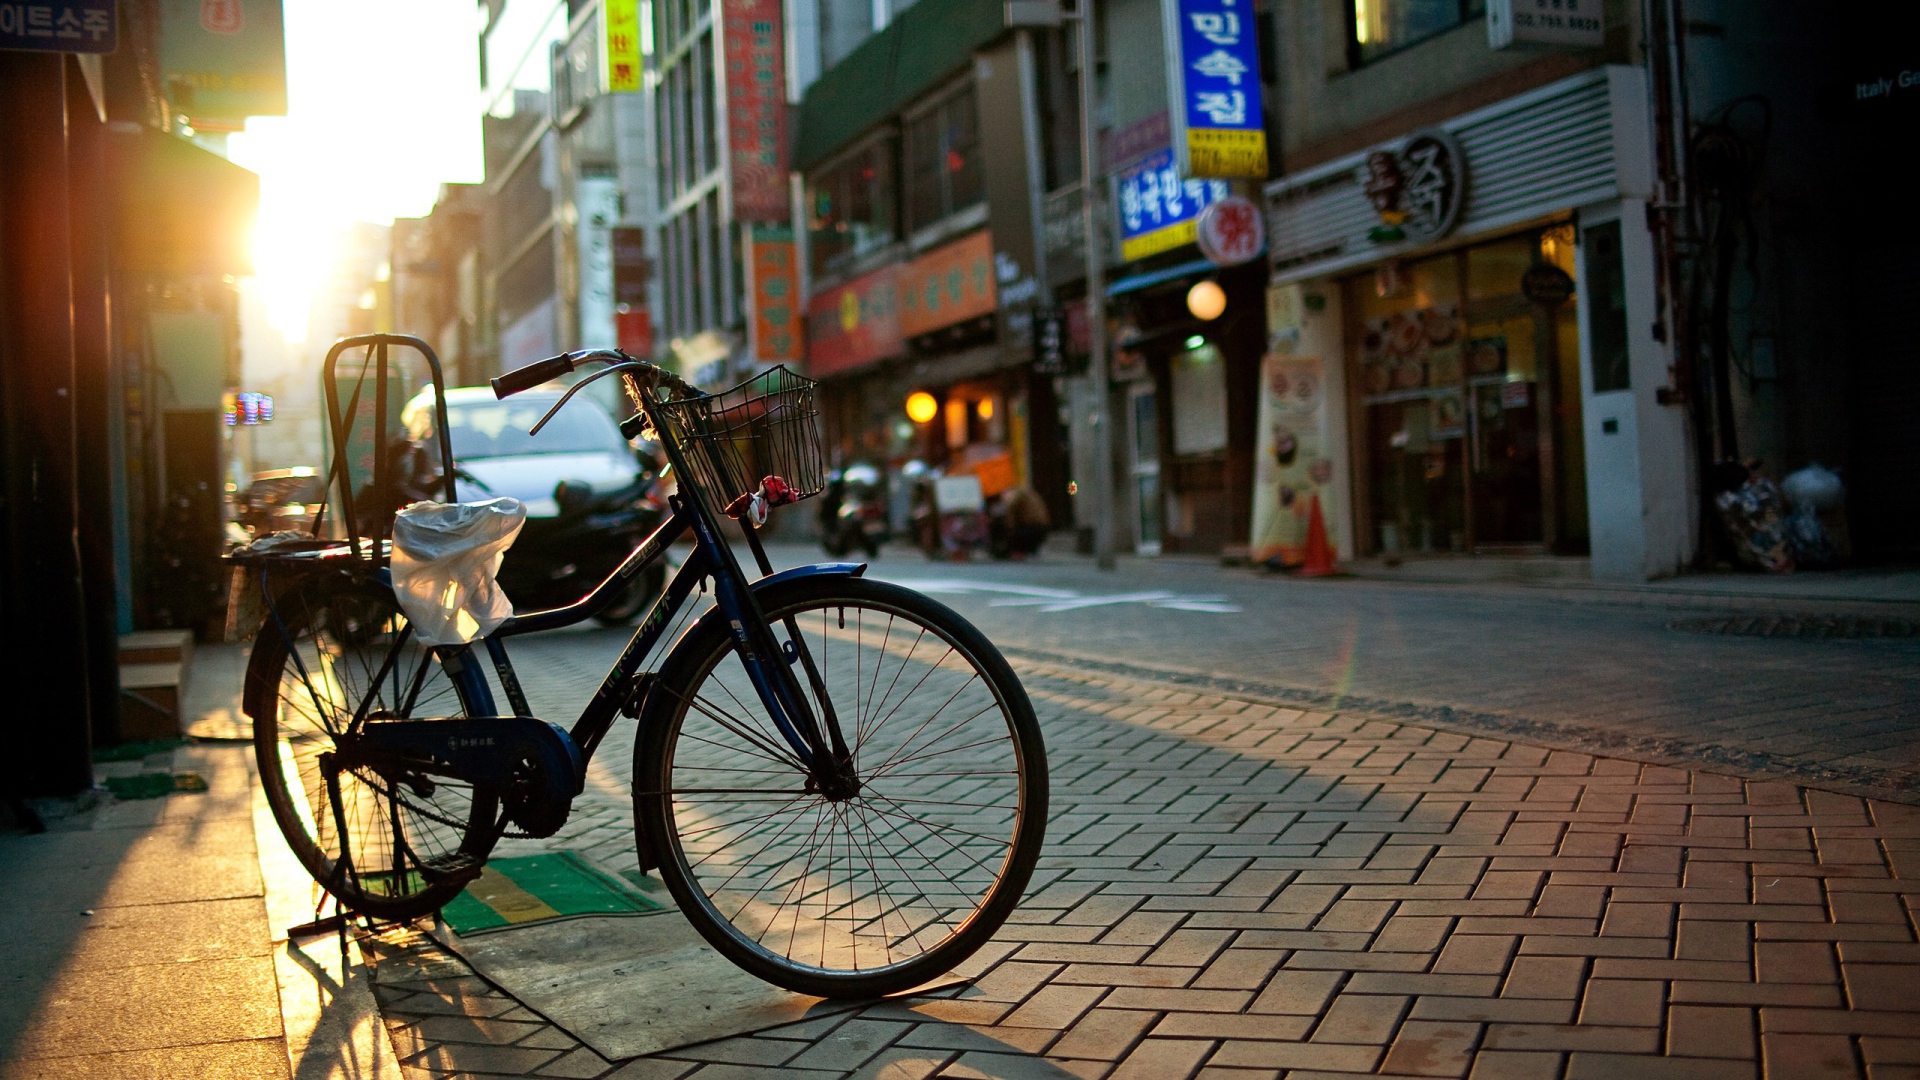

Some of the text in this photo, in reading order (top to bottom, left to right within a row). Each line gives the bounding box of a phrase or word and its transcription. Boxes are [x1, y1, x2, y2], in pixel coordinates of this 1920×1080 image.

[0, 5, 109, 41] 이트소주
[1189, 0, 1249, 125] 민속집
[1856, 77, 1894, 100] Italy
